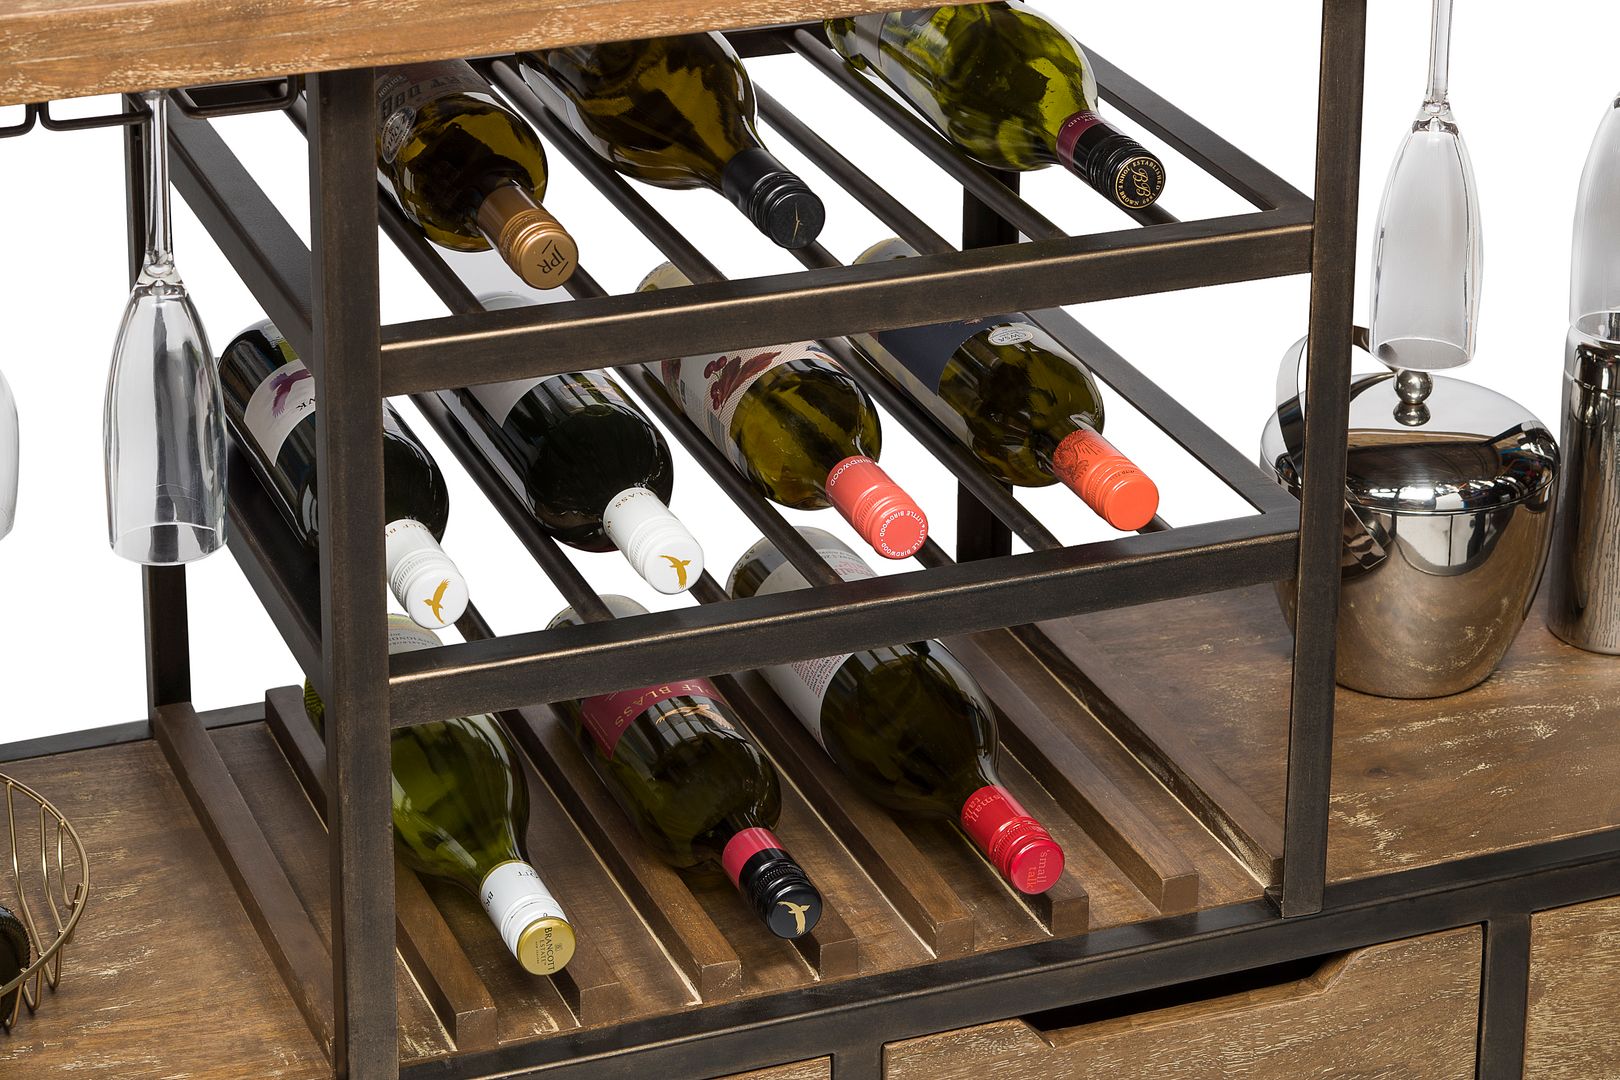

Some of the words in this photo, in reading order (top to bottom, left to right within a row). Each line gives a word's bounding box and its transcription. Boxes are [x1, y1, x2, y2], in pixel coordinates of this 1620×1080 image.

[1118, 166, 1131, 184] JOHN
[1132, 159, 1162, 190] ESTABLISHED
[1119, 190, 1139, 206] BROWN
[537, 244, 566, 275] JPR
[879, 510, 905, 537] BIRDWOOD
[906, 510, 924, 524] LITTLE
[881, 542, 911, 557] BIRDWOOD
[911, 529, 925, 550] LITTLE
[614, 685, 672, 728] BLASS
[544, 926, 556, 971] BRANCOTT
